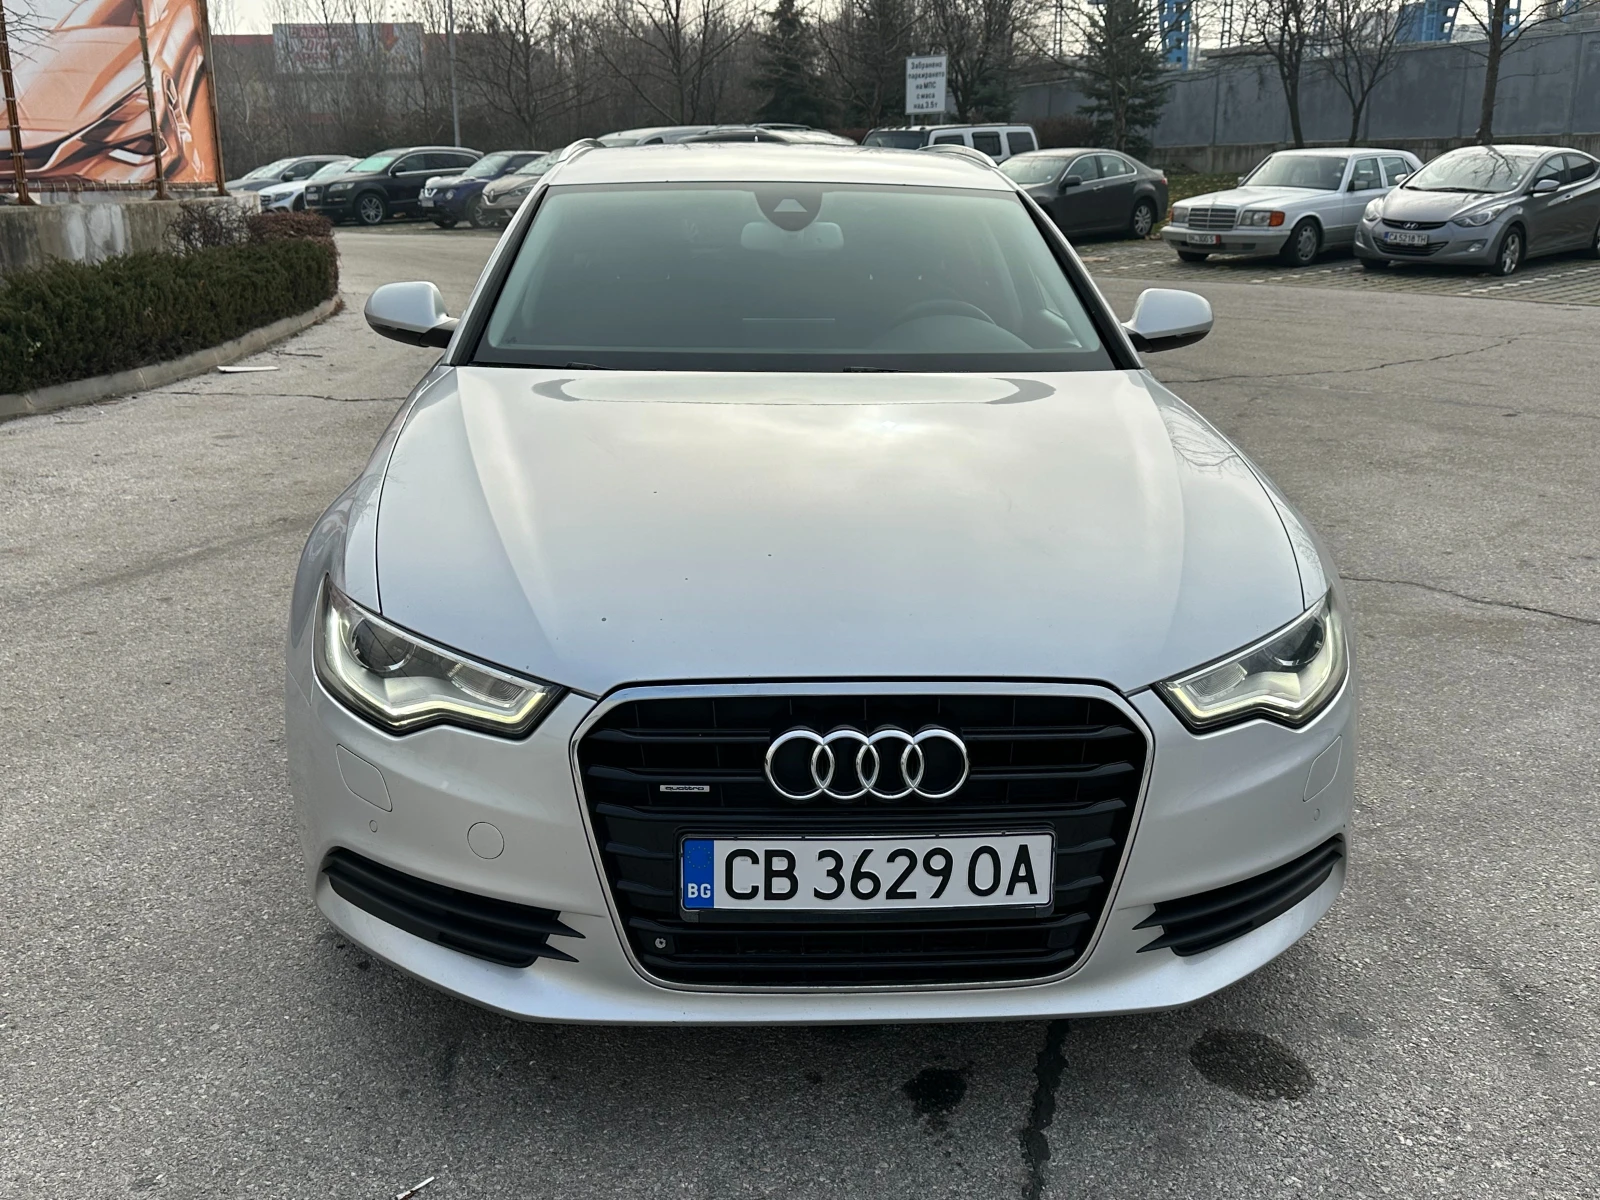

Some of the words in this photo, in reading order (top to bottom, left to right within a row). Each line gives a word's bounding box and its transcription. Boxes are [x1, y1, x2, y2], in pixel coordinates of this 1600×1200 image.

[911, 62, 942, 70] Забранено
[908, 71, 945, 80] паркирането
[924, 81, 936, 89] МПС
[725, 848, 799, 900] CB
[814, 847, 953, 901] 3629
[968, 844, 1038, 897] OA
[687, 883, 711, 898] BG
